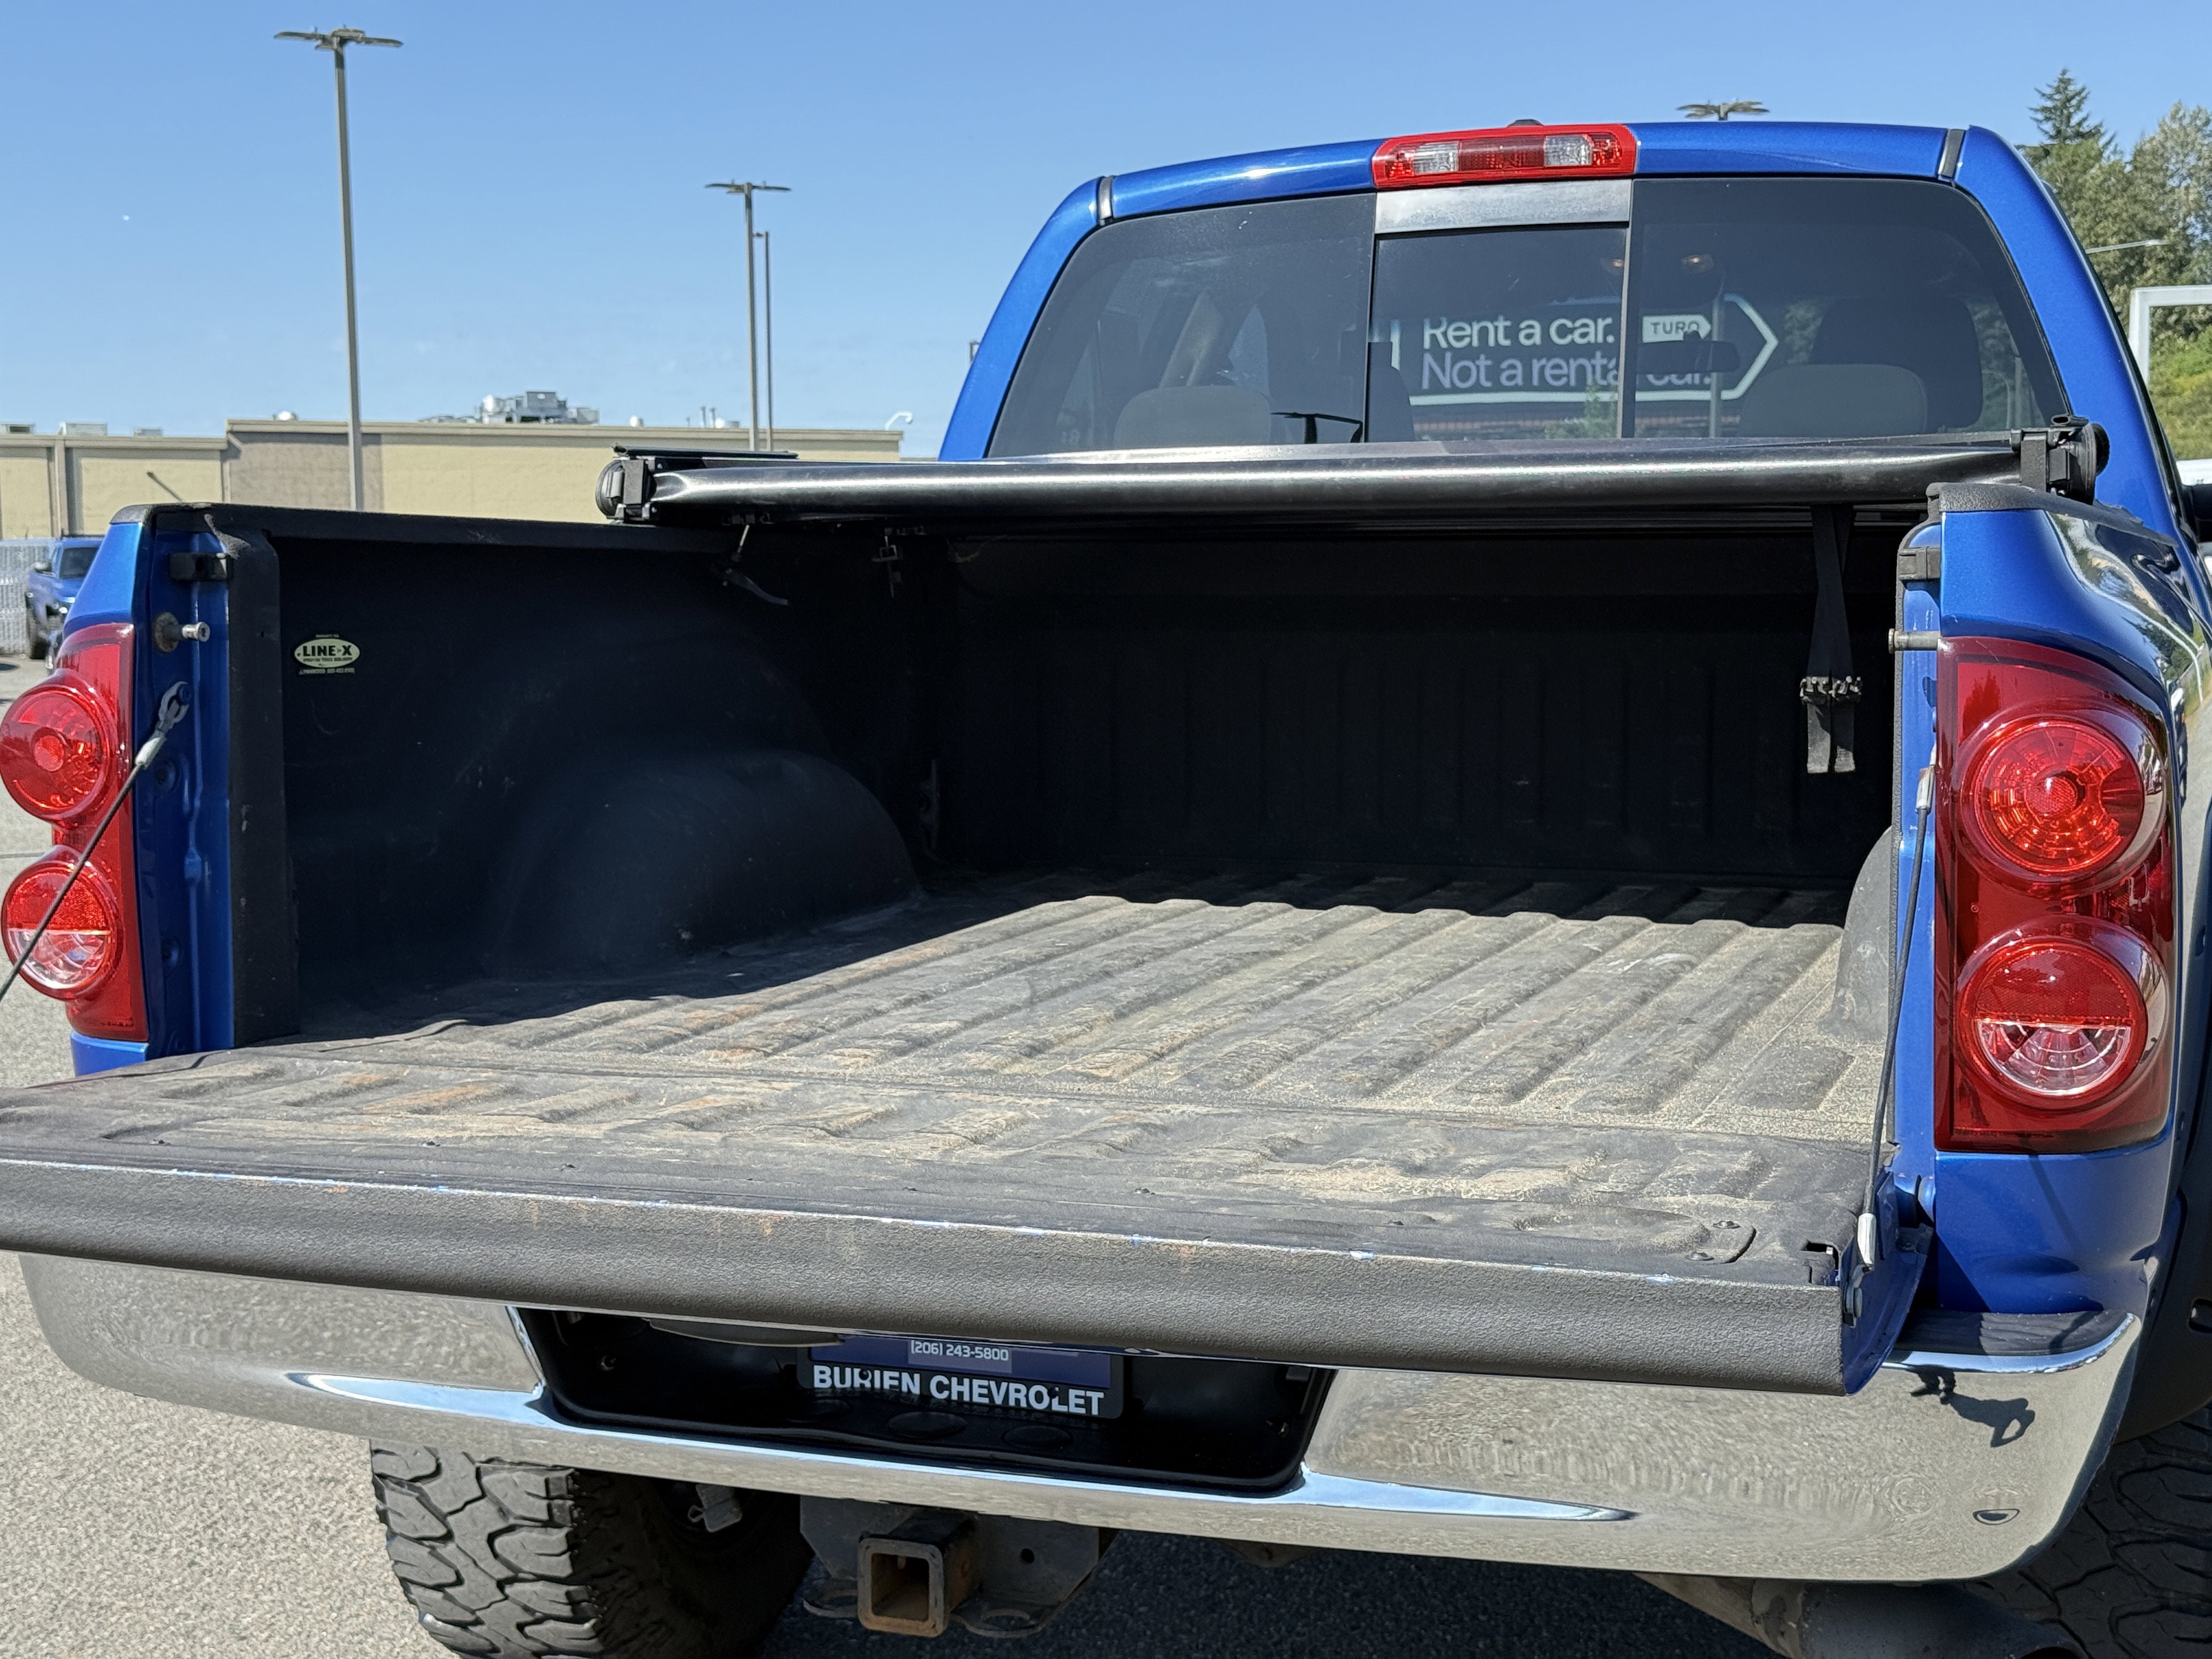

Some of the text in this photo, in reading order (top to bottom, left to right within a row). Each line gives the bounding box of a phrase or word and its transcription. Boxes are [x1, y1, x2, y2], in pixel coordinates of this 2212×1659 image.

[1424, 315, 1615, 349] Rent a car.
[1650, 320, 1700, 335] TURO
[1422, 350, 1639, 389] Not a renta
[303, 645, 352, 657] LINE-X
[911, 1340, 1009, 1361] (206) 243-5800
[813, 1365, 1104, 1415] BURIEN CHEVROLET
